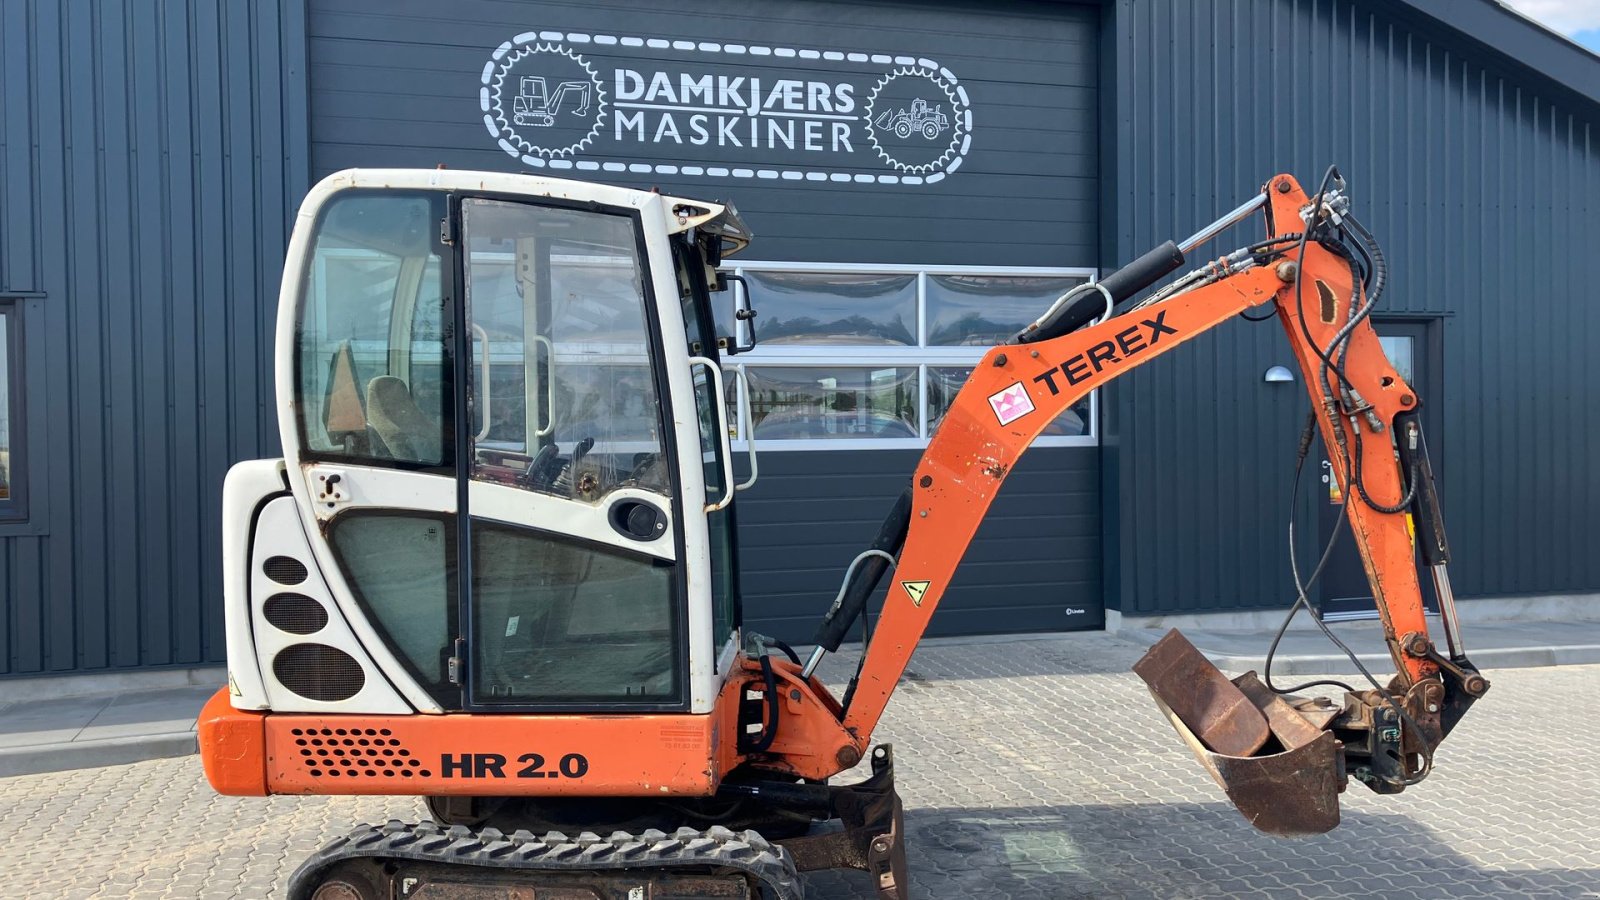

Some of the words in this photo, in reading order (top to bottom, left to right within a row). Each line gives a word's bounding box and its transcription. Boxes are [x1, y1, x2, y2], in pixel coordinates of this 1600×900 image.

[614, 68, 856, 116] DAMKJÆRS
[614, 111, 855, 153] MASKINER
[1034, 310, 1178, 395] TEREX
[441, 753, 506, 778] HR
[517, 753, 589, 778] 2.0
